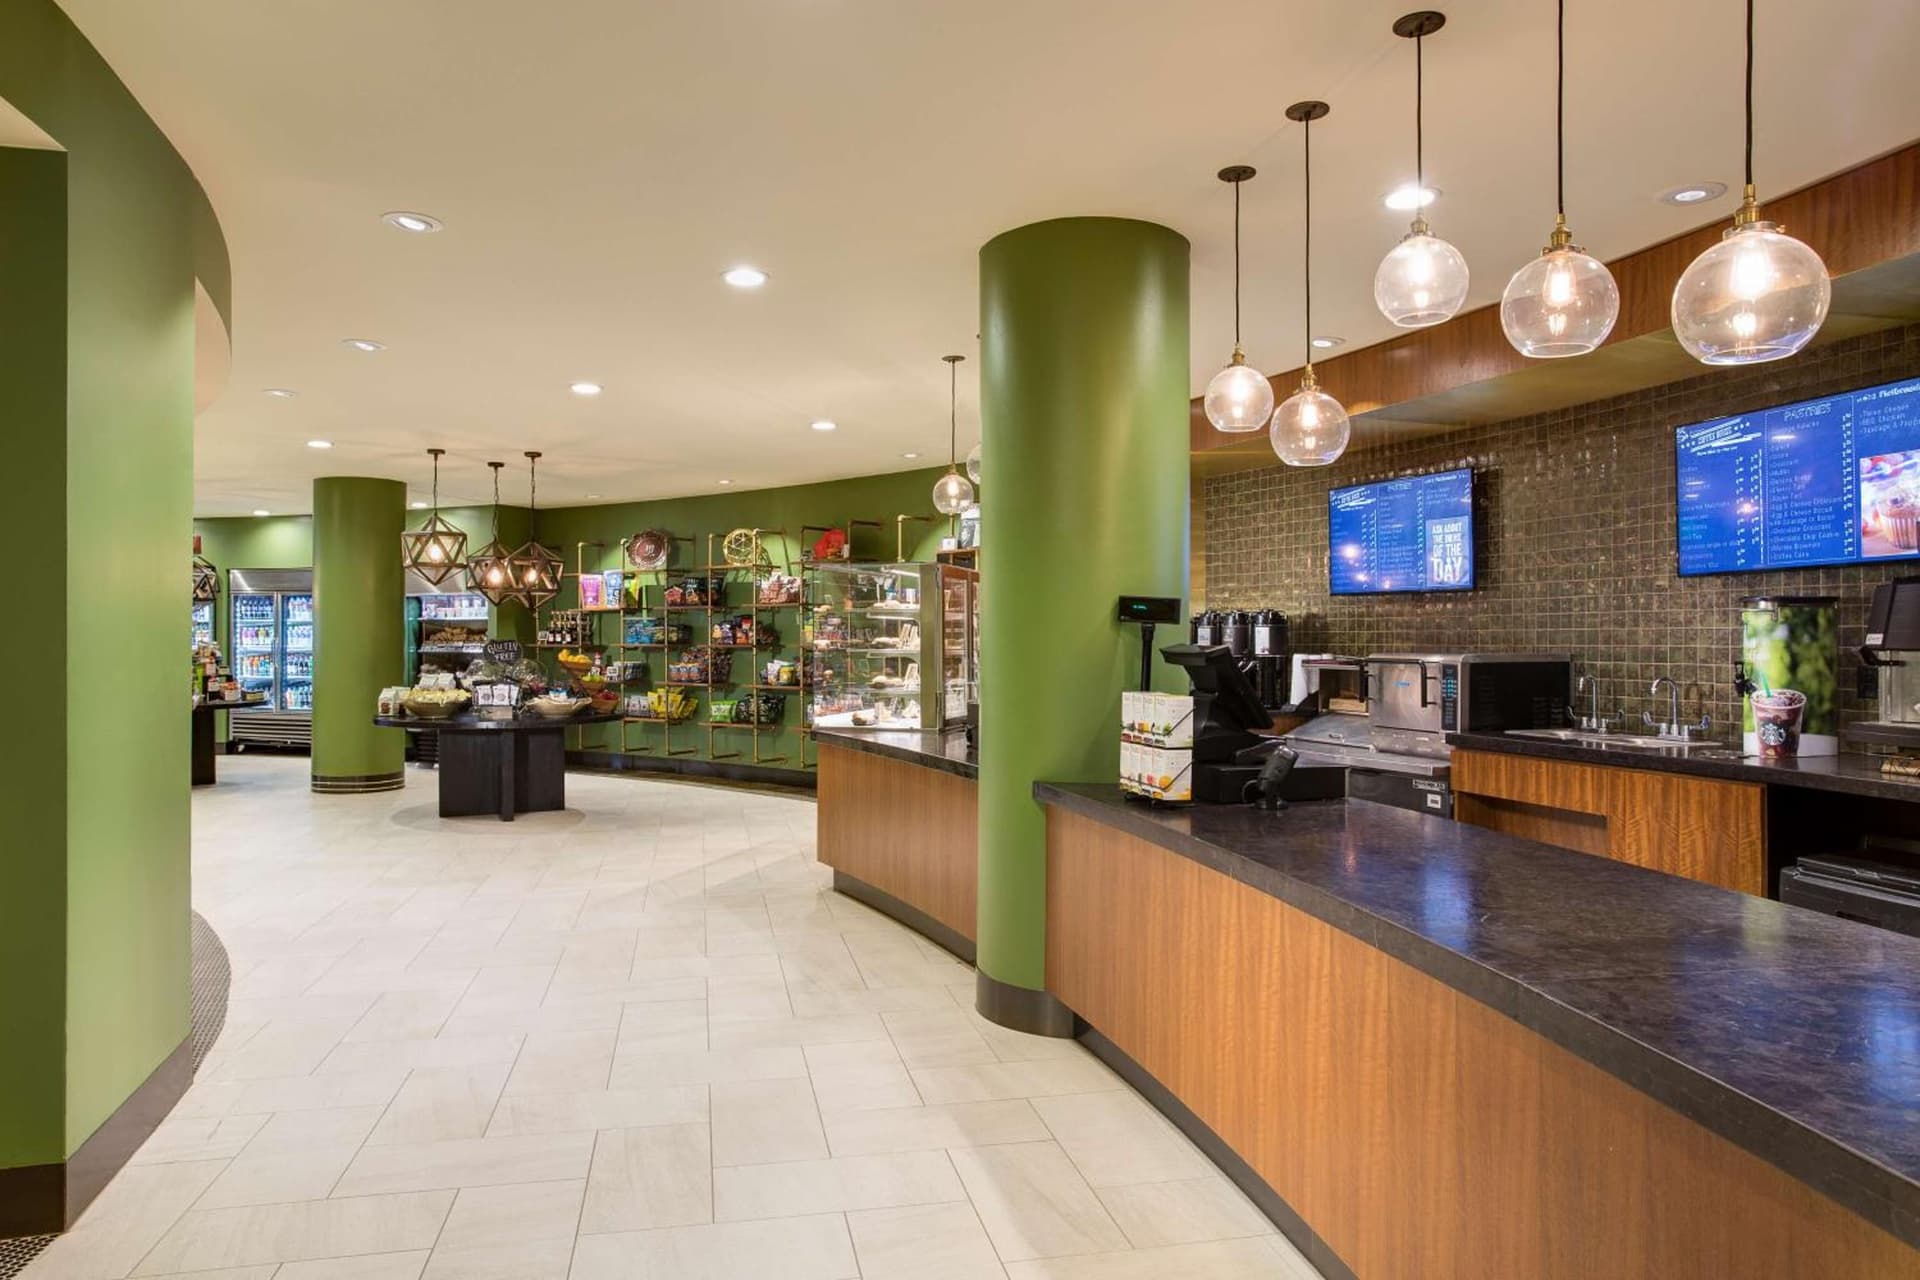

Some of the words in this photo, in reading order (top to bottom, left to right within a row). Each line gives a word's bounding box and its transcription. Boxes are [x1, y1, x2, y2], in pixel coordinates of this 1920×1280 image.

[1783, 401, 1832, 421] PASTRIES
[1445, 542, 1463, 557] THE
[1431, 556, 1463, 583] DAY
[487, 641, 519, 655] GLUTEN
[494, 652, 517, 662] FREE
